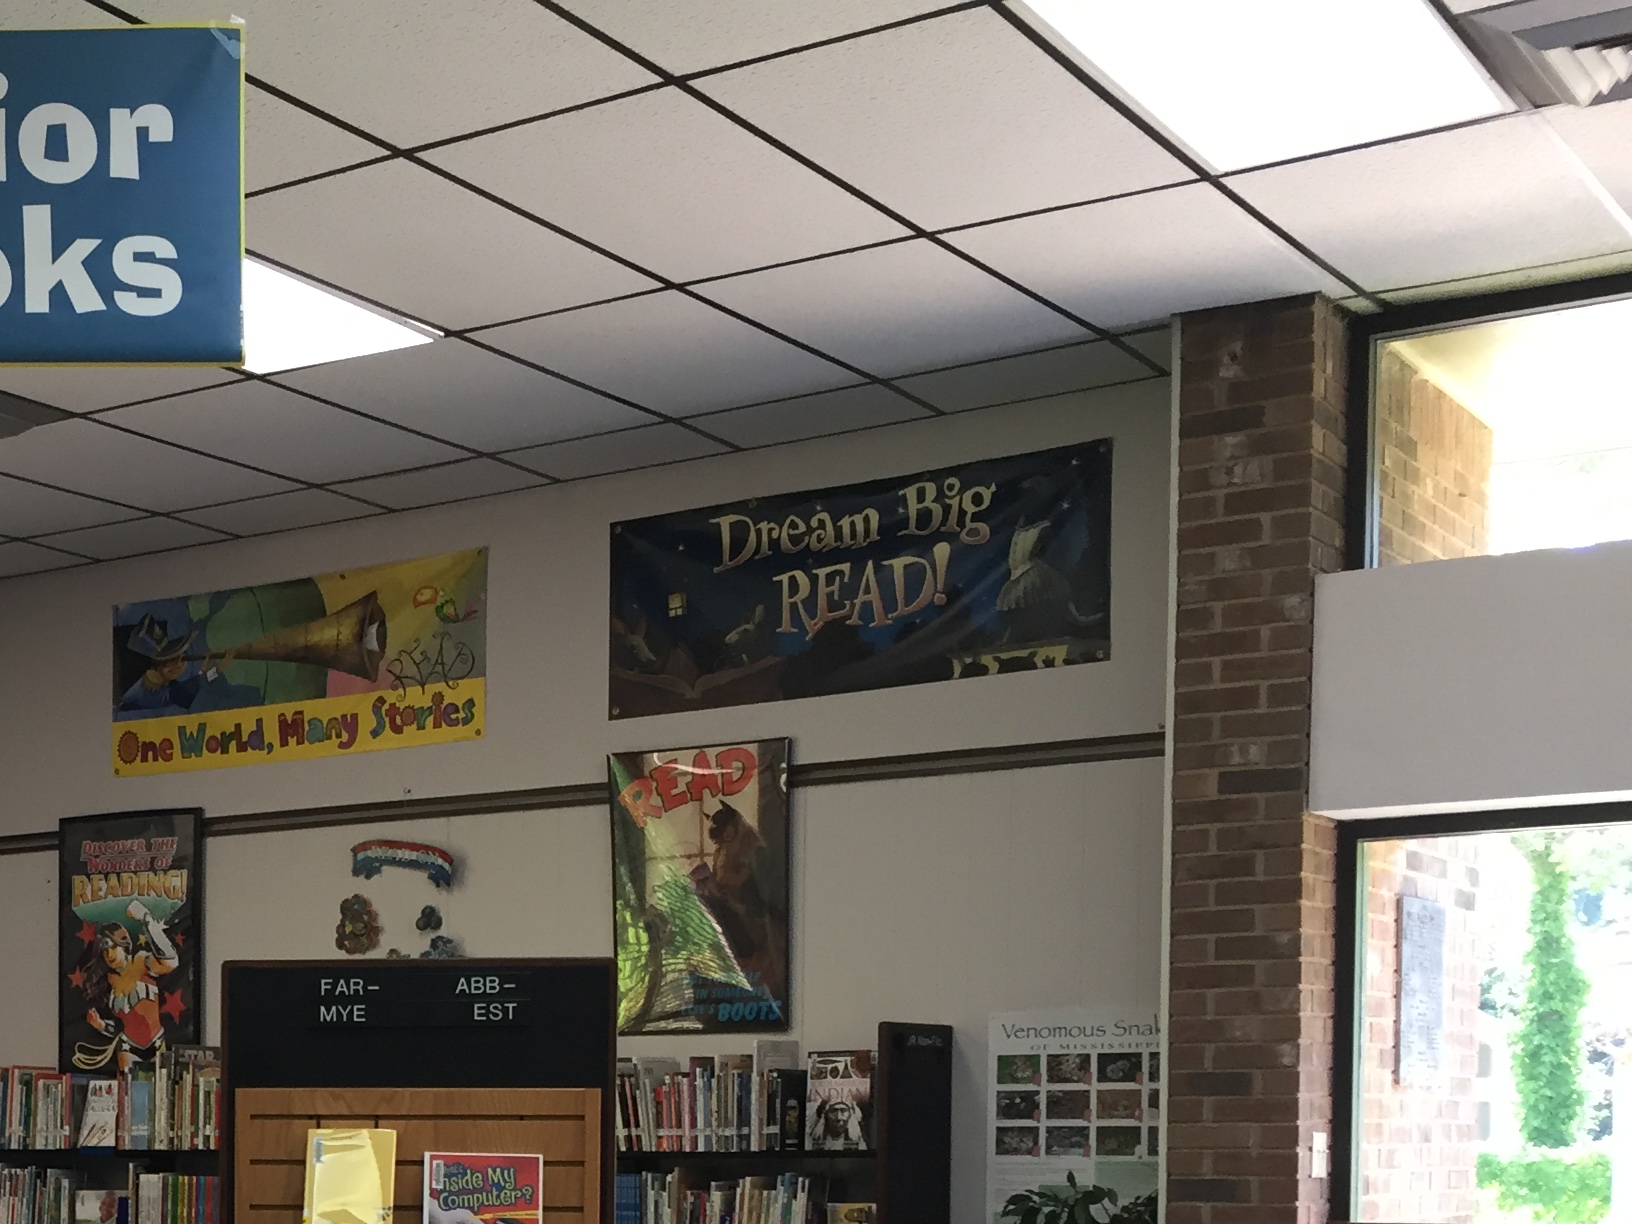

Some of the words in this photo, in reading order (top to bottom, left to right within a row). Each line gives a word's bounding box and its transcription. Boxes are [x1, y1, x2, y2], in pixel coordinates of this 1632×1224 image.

[709, 507, 881, 573] Dream
[897, 476, 997, 546] Big
[772, 541, 951, 641] READ!
[117, 731, 174, 764] One
[278, 710, 359, 750] Many
[369, 691, 476, 739] Stories
[619, 747, 757, 828] READ
[82, 839, 148, 856] DISCOVER
[151, 837, 178, 855] THE
[87, 855, 151, 873] WONDERS
[153, 854, 174, 871] OF
[71, 869, 188, 908] READING!
[320, 979, 380, 996] FAR-
[455, 976, 516, 994] ABB-
[320, 1005, 366, 1022] MYE
[473, 1003, 518, 1020] EST
[717, 1000, 783, 1022] BOOTS
[1001, 1023, 1106, 1039] Venomous
[440, 1169, 483, 1191] nside
[487, 1167, 515, 1190] My
[439, 1186, 533, 1212] Computer?
